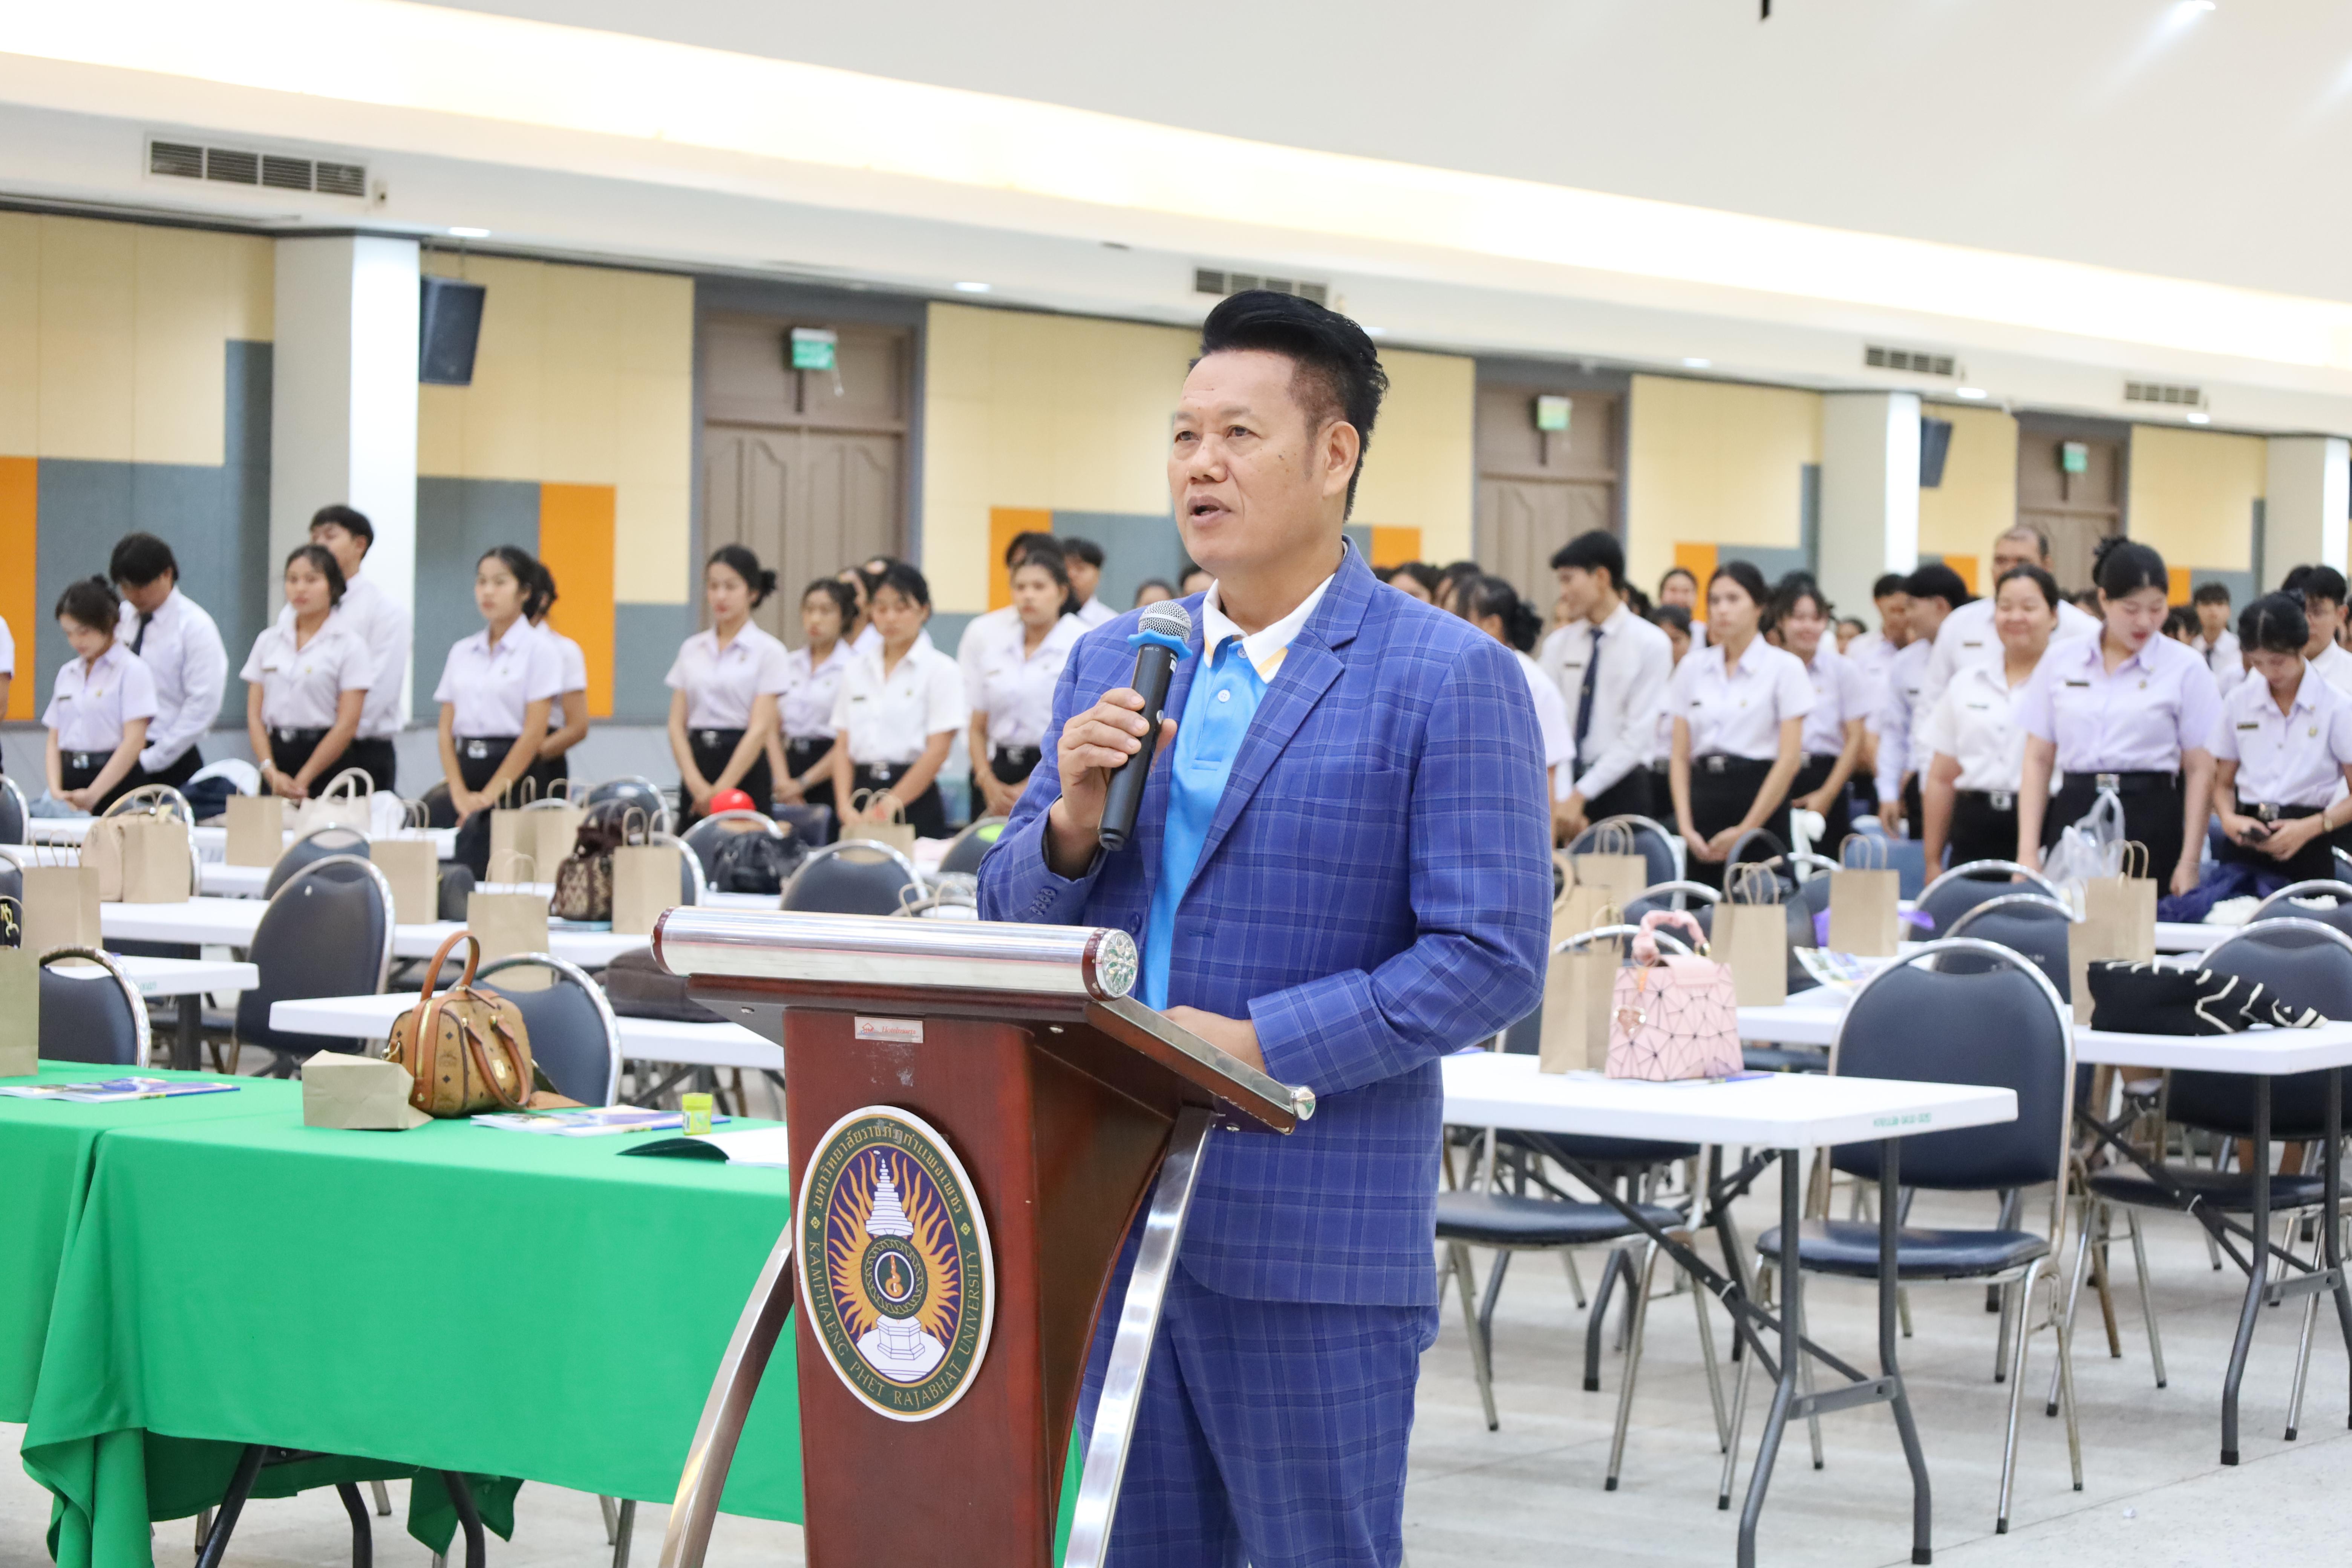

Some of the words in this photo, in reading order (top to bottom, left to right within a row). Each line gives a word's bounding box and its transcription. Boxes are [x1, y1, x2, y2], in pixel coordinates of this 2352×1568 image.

[809, 1241, 849, 1356] KAMPHAENG
[850, 1361, 885, 1397] PHET
[894, 1360, 962, 1409] RAJABHAT
[958, 1250, 979, 1355] UNIVERSITY
